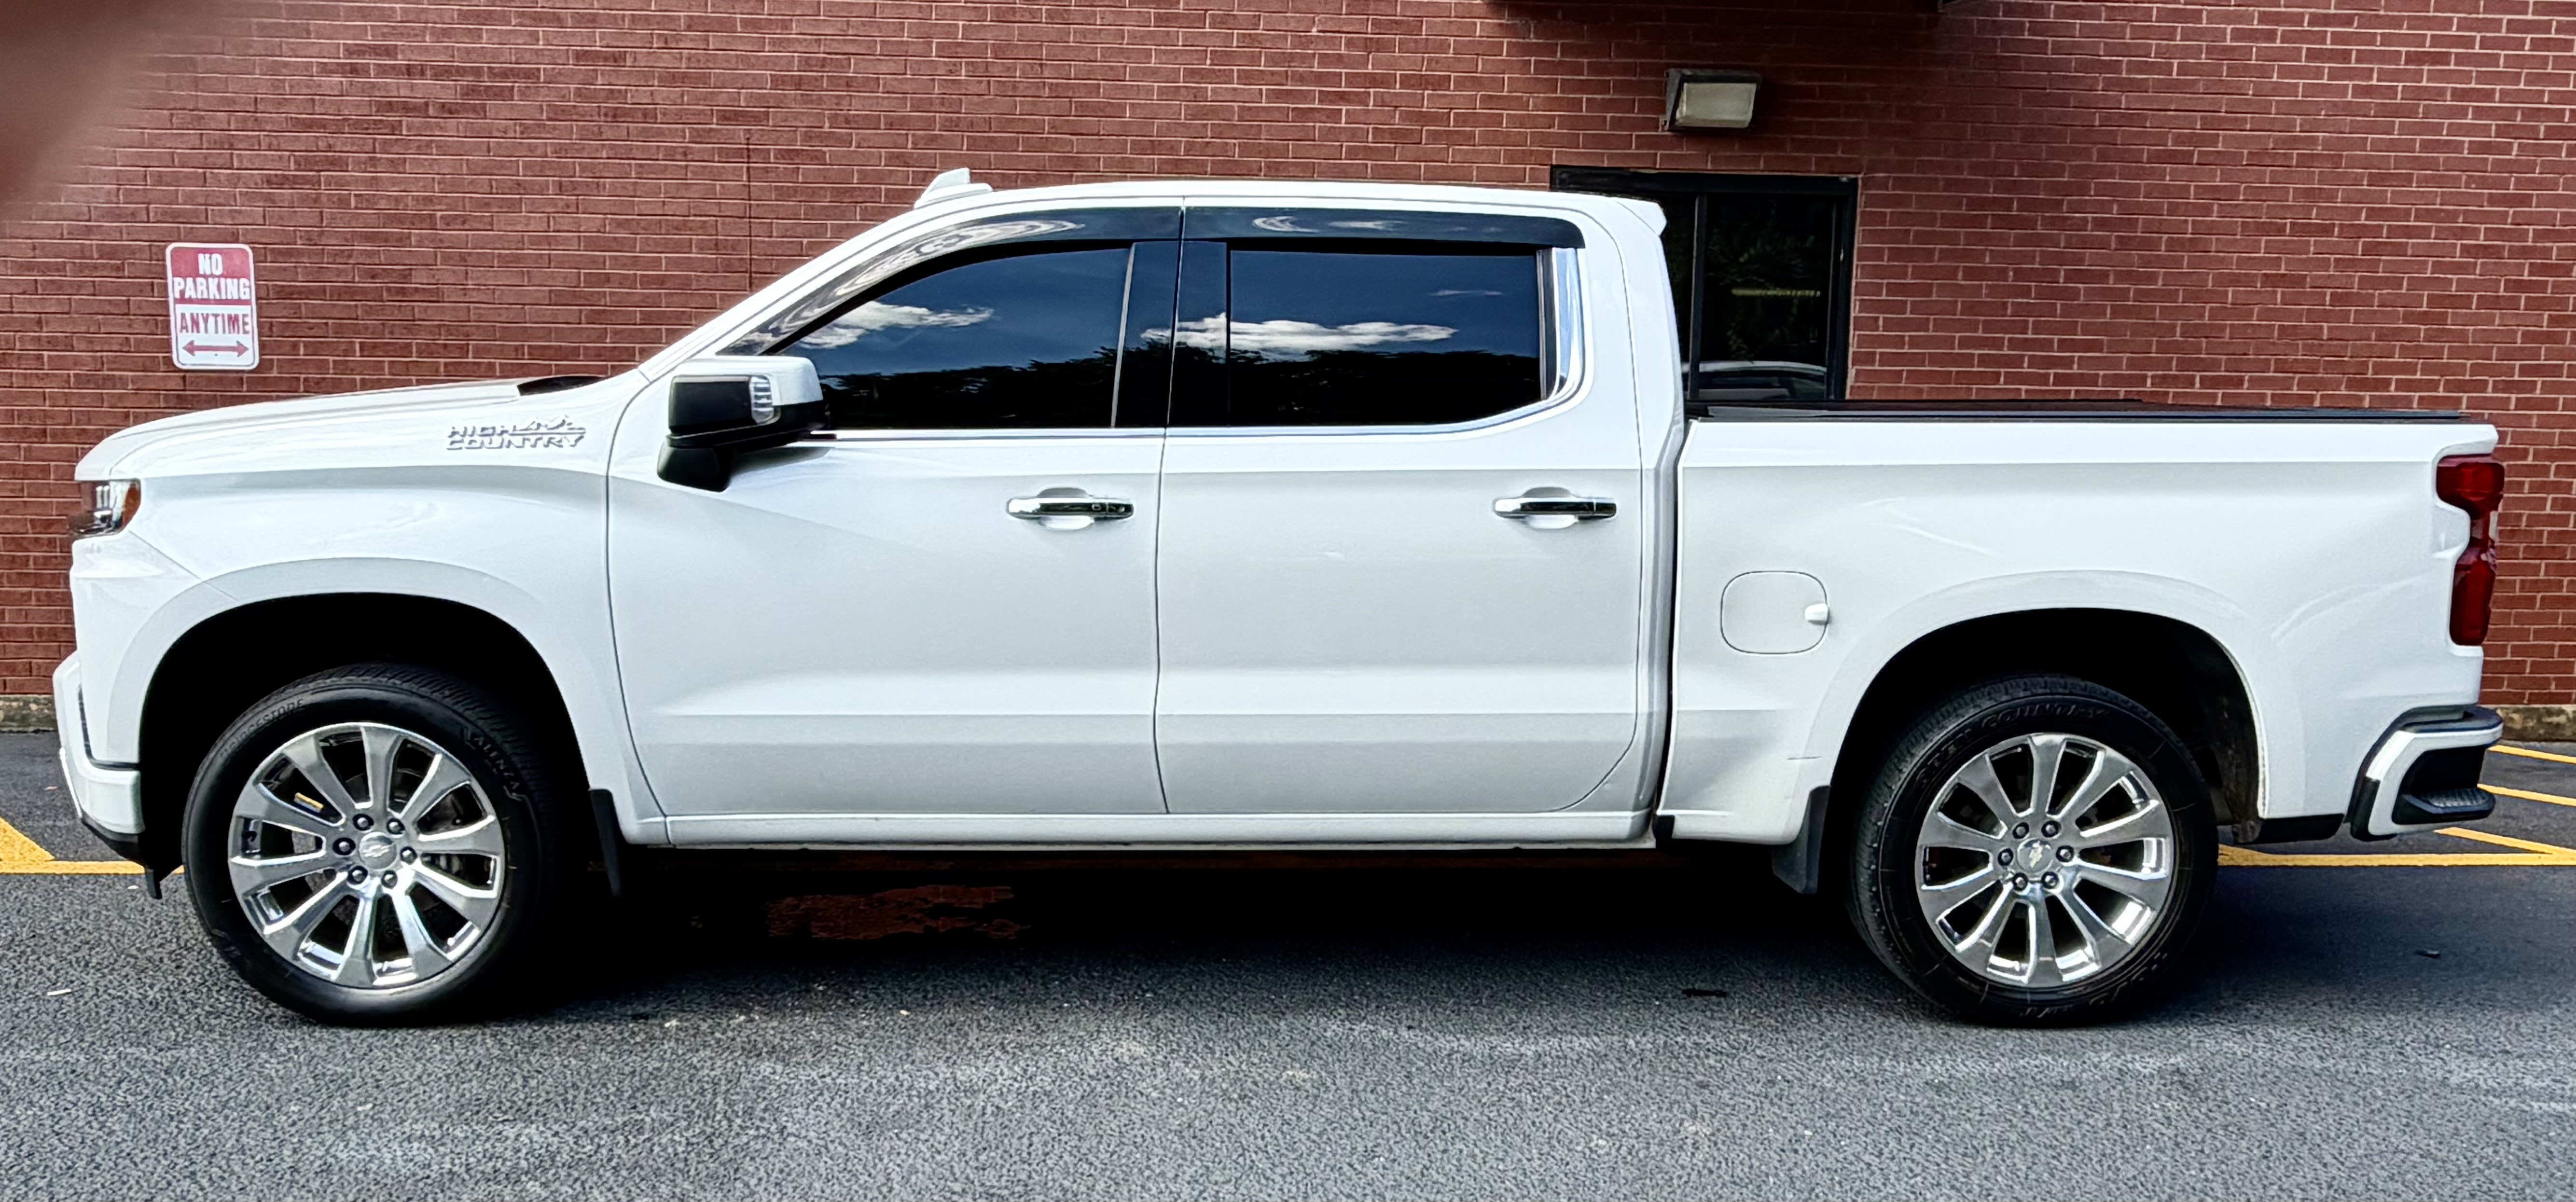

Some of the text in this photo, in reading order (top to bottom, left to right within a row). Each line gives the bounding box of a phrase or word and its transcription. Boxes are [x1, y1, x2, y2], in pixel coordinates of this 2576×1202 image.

[198, 253, 223, 275] NO
[173, 277, 250, 299] PARKING
[180, 312, 249, 334] ANYTIME
[446, 435, 585, 450] COUNTRY
[448, 425, 510, 438] HIGH
